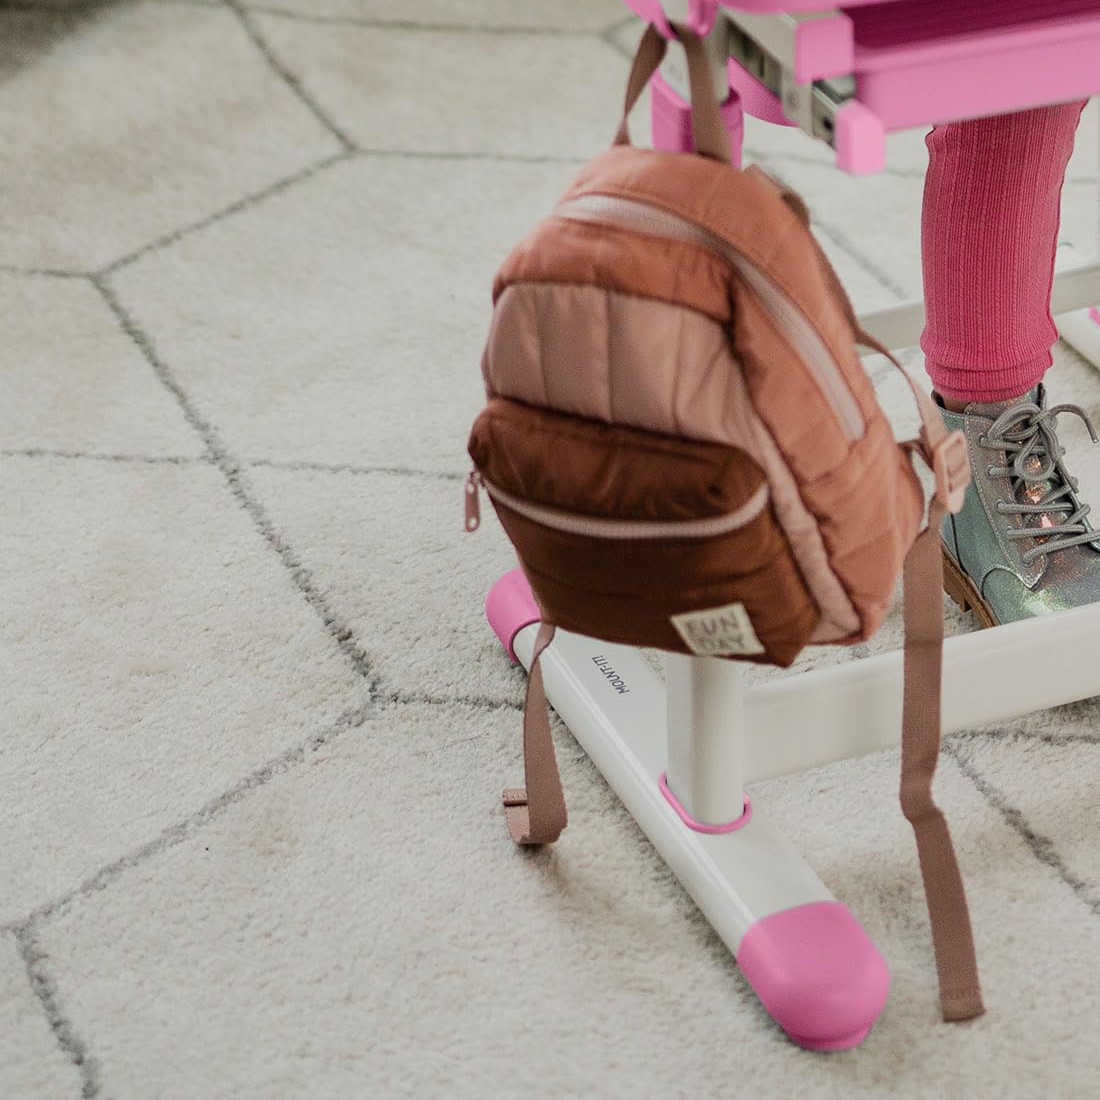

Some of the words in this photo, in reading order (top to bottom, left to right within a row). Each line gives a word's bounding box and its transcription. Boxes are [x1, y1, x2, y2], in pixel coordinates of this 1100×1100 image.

[685, 610, 740, 638] FUN
[699, 632, 746, 651] DAY
[591, 654, 631, 695] MOUNT-IT!
